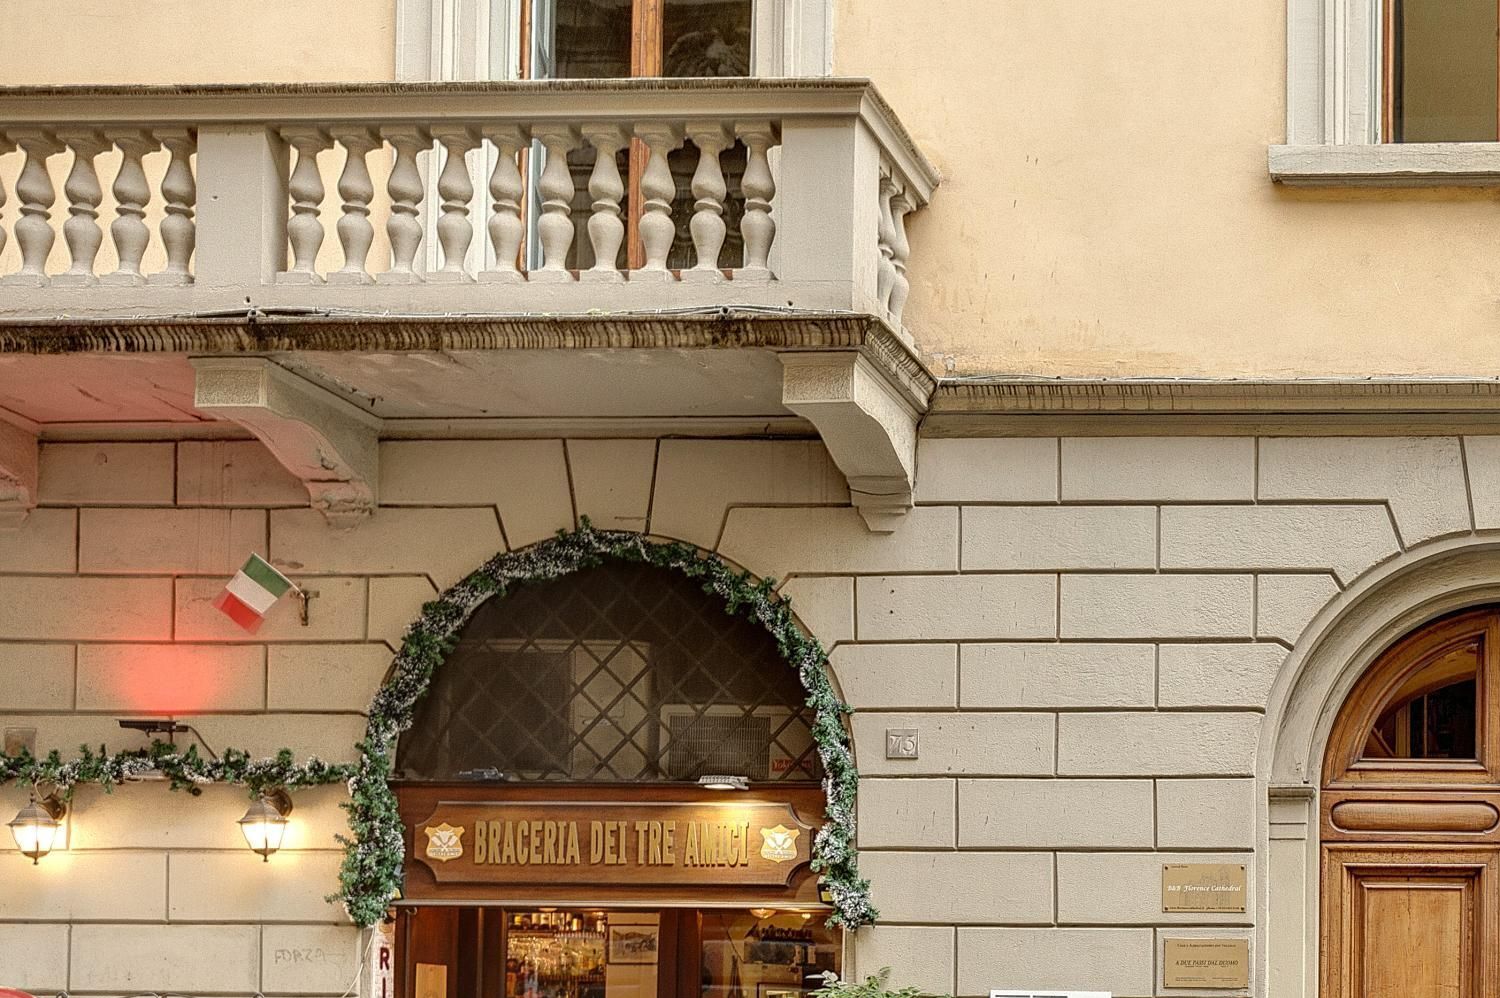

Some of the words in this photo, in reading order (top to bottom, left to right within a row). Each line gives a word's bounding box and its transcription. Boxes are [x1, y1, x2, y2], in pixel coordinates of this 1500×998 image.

[474, 820, 580, 866] BRACERIA
[590, 820, 628, 866] DEI
[635, 820, 676, 867] TRE
[684, 820, 749, 868] AMICI
[1183, 884, 1210, 893] Florence
[1210, 884, 1242, 892] Cathedral
